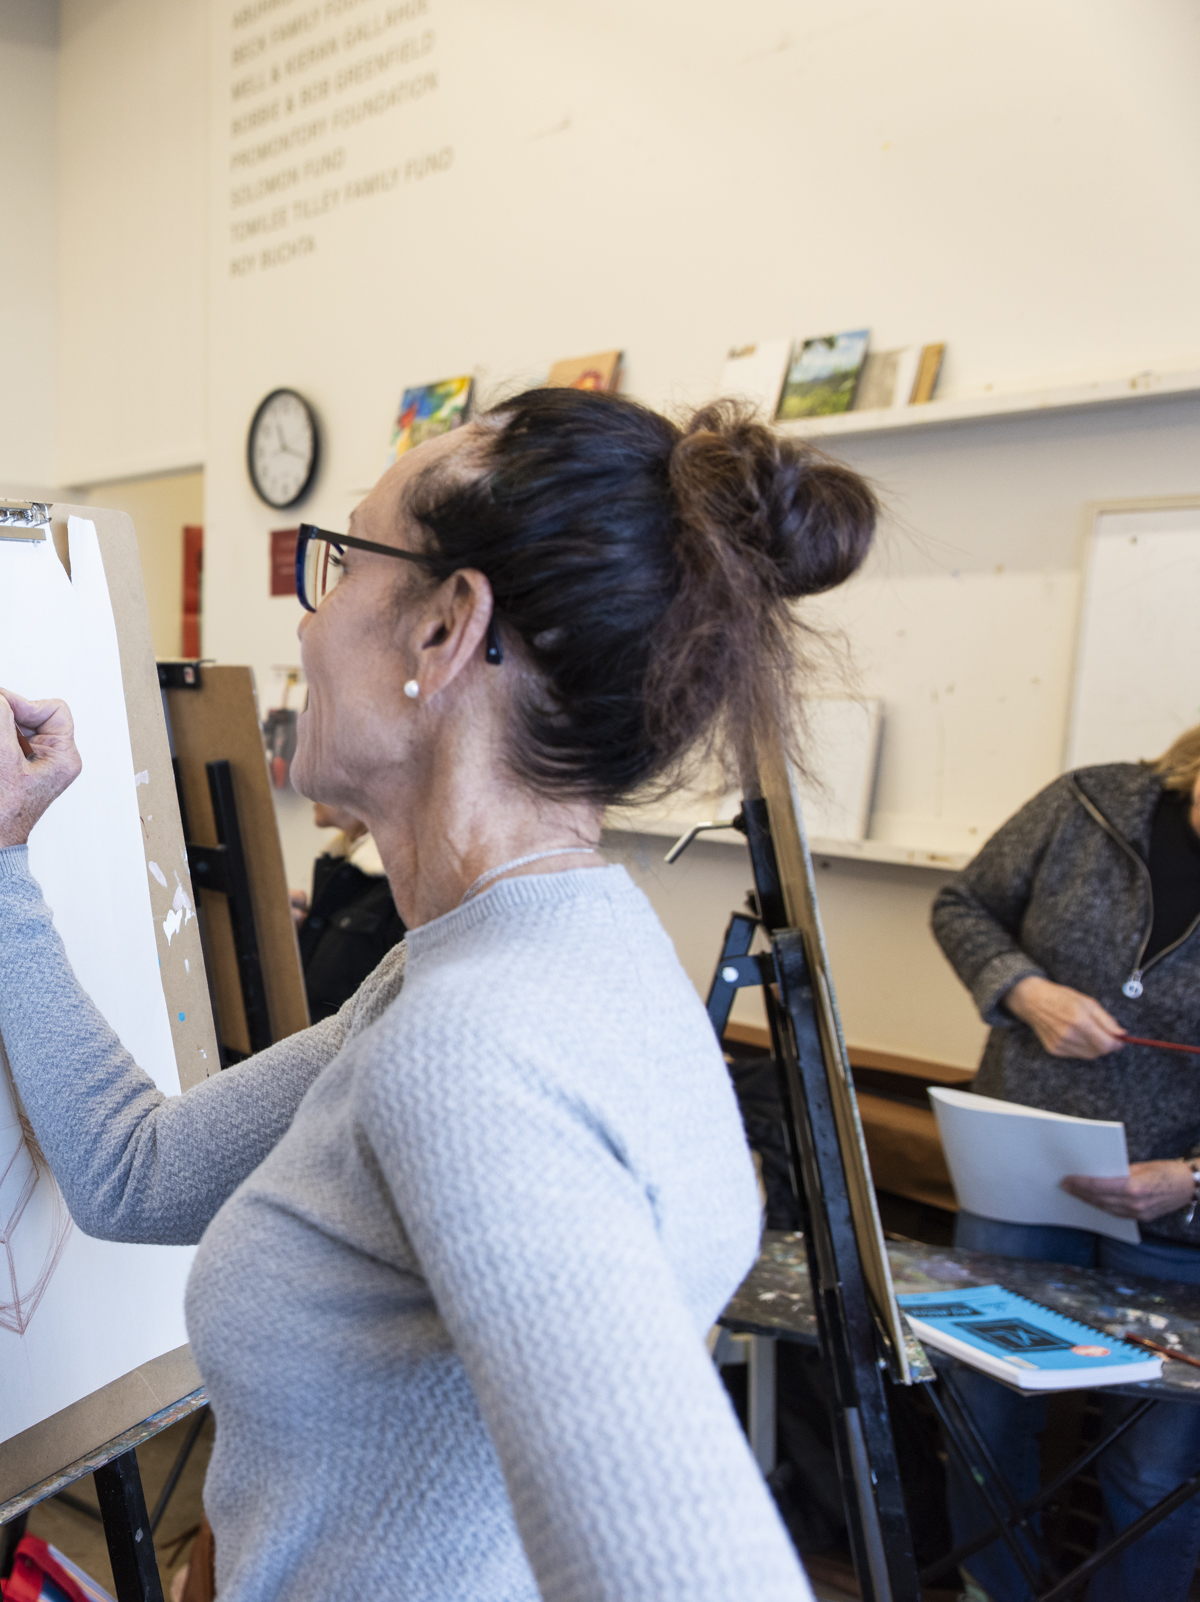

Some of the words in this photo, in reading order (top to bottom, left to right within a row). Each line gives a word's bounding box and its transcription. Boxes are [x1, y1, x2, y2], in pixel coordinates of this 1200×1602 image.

[230, 35, 267, 66] BECK
[270, 6, 321, 47] FAMILY
[270, 64, 282, 85] &
[285, 37, 338, 77] KIERAN
[230, 103, 280, 138] BOBBIE
[284, 94, 296, 115] &
[300, 78, 331, 107] BOB
[335, 29, 436, 92] GREENFIELD
[230, 117, 328, 172] PROMONTORY
[331, 70, 439, 132] FOUNDATION
[230, 165, 299, 208] SOLOMON
[303, 148, 346, 179] FUND
[230, 207, 288, 242] TOMILEE
[292, 187, 341, 220] TILLEY
[344, 165, 400, 203] FAMILY
[404, 146, 455, 184] FUND
[229, 254, 257, 279] ROY
